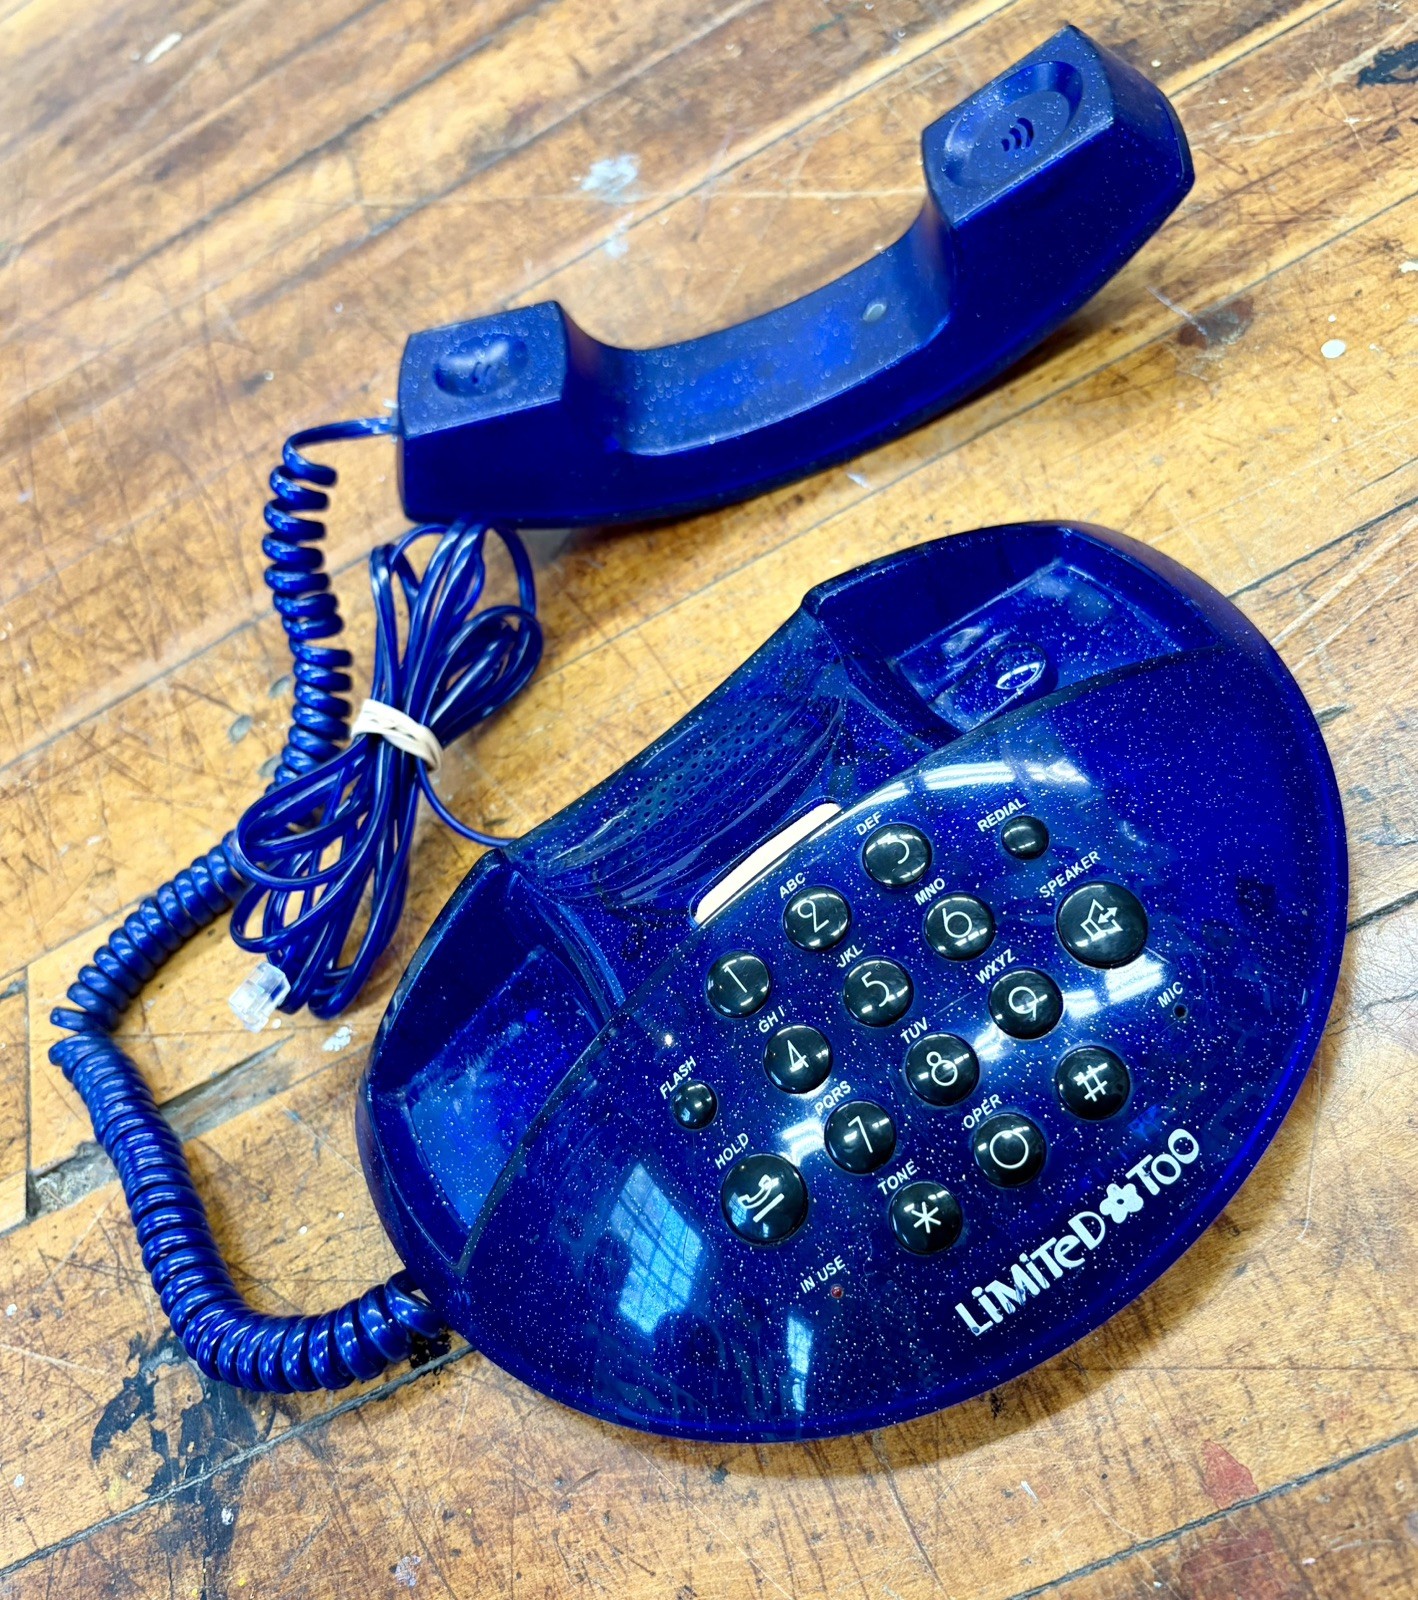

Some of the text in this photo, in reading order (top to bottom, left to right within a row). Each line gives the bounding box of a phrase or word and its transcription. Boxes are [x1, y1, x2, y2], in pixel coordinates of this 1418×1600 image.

[855, 813, 883, 836] DEF
[977, 798, 1027, 833] REDIAL
[779, 872, 806, 899] ABC
[914, 877, 946, 906] MNO
[1039, 850, 1101, 899] SPEAKER
[797, 899, 829, 933] 2
[942, 907, 972, 939] 6
[837, 943, 864, 969] JKL
[975, 948, 1017, 985] WXYZ
[723, 965, 748, 993] 1
[861, 971, 890, 1008] 5
[1157, 981, 1184, 1009] MIC
[1008, 986, 1037, 1021] 9
[900, 1016, 930, 1045] TUV
[786, 1039, 810, 1073] 4
[926, 1051, 958, 1087] 8
[659, 1055, 698, 1100] FLASH
[814, 1080, 852, 1116] PQRS
[963, 1093, 1003, 1129] OPER
[714, 1132, 750, 1170] HOLD
[847, 1115, 874, 1153] 7
[877, 1160, 918, 1196] TONE
[800, 1255, 847, 1295] IN USE
